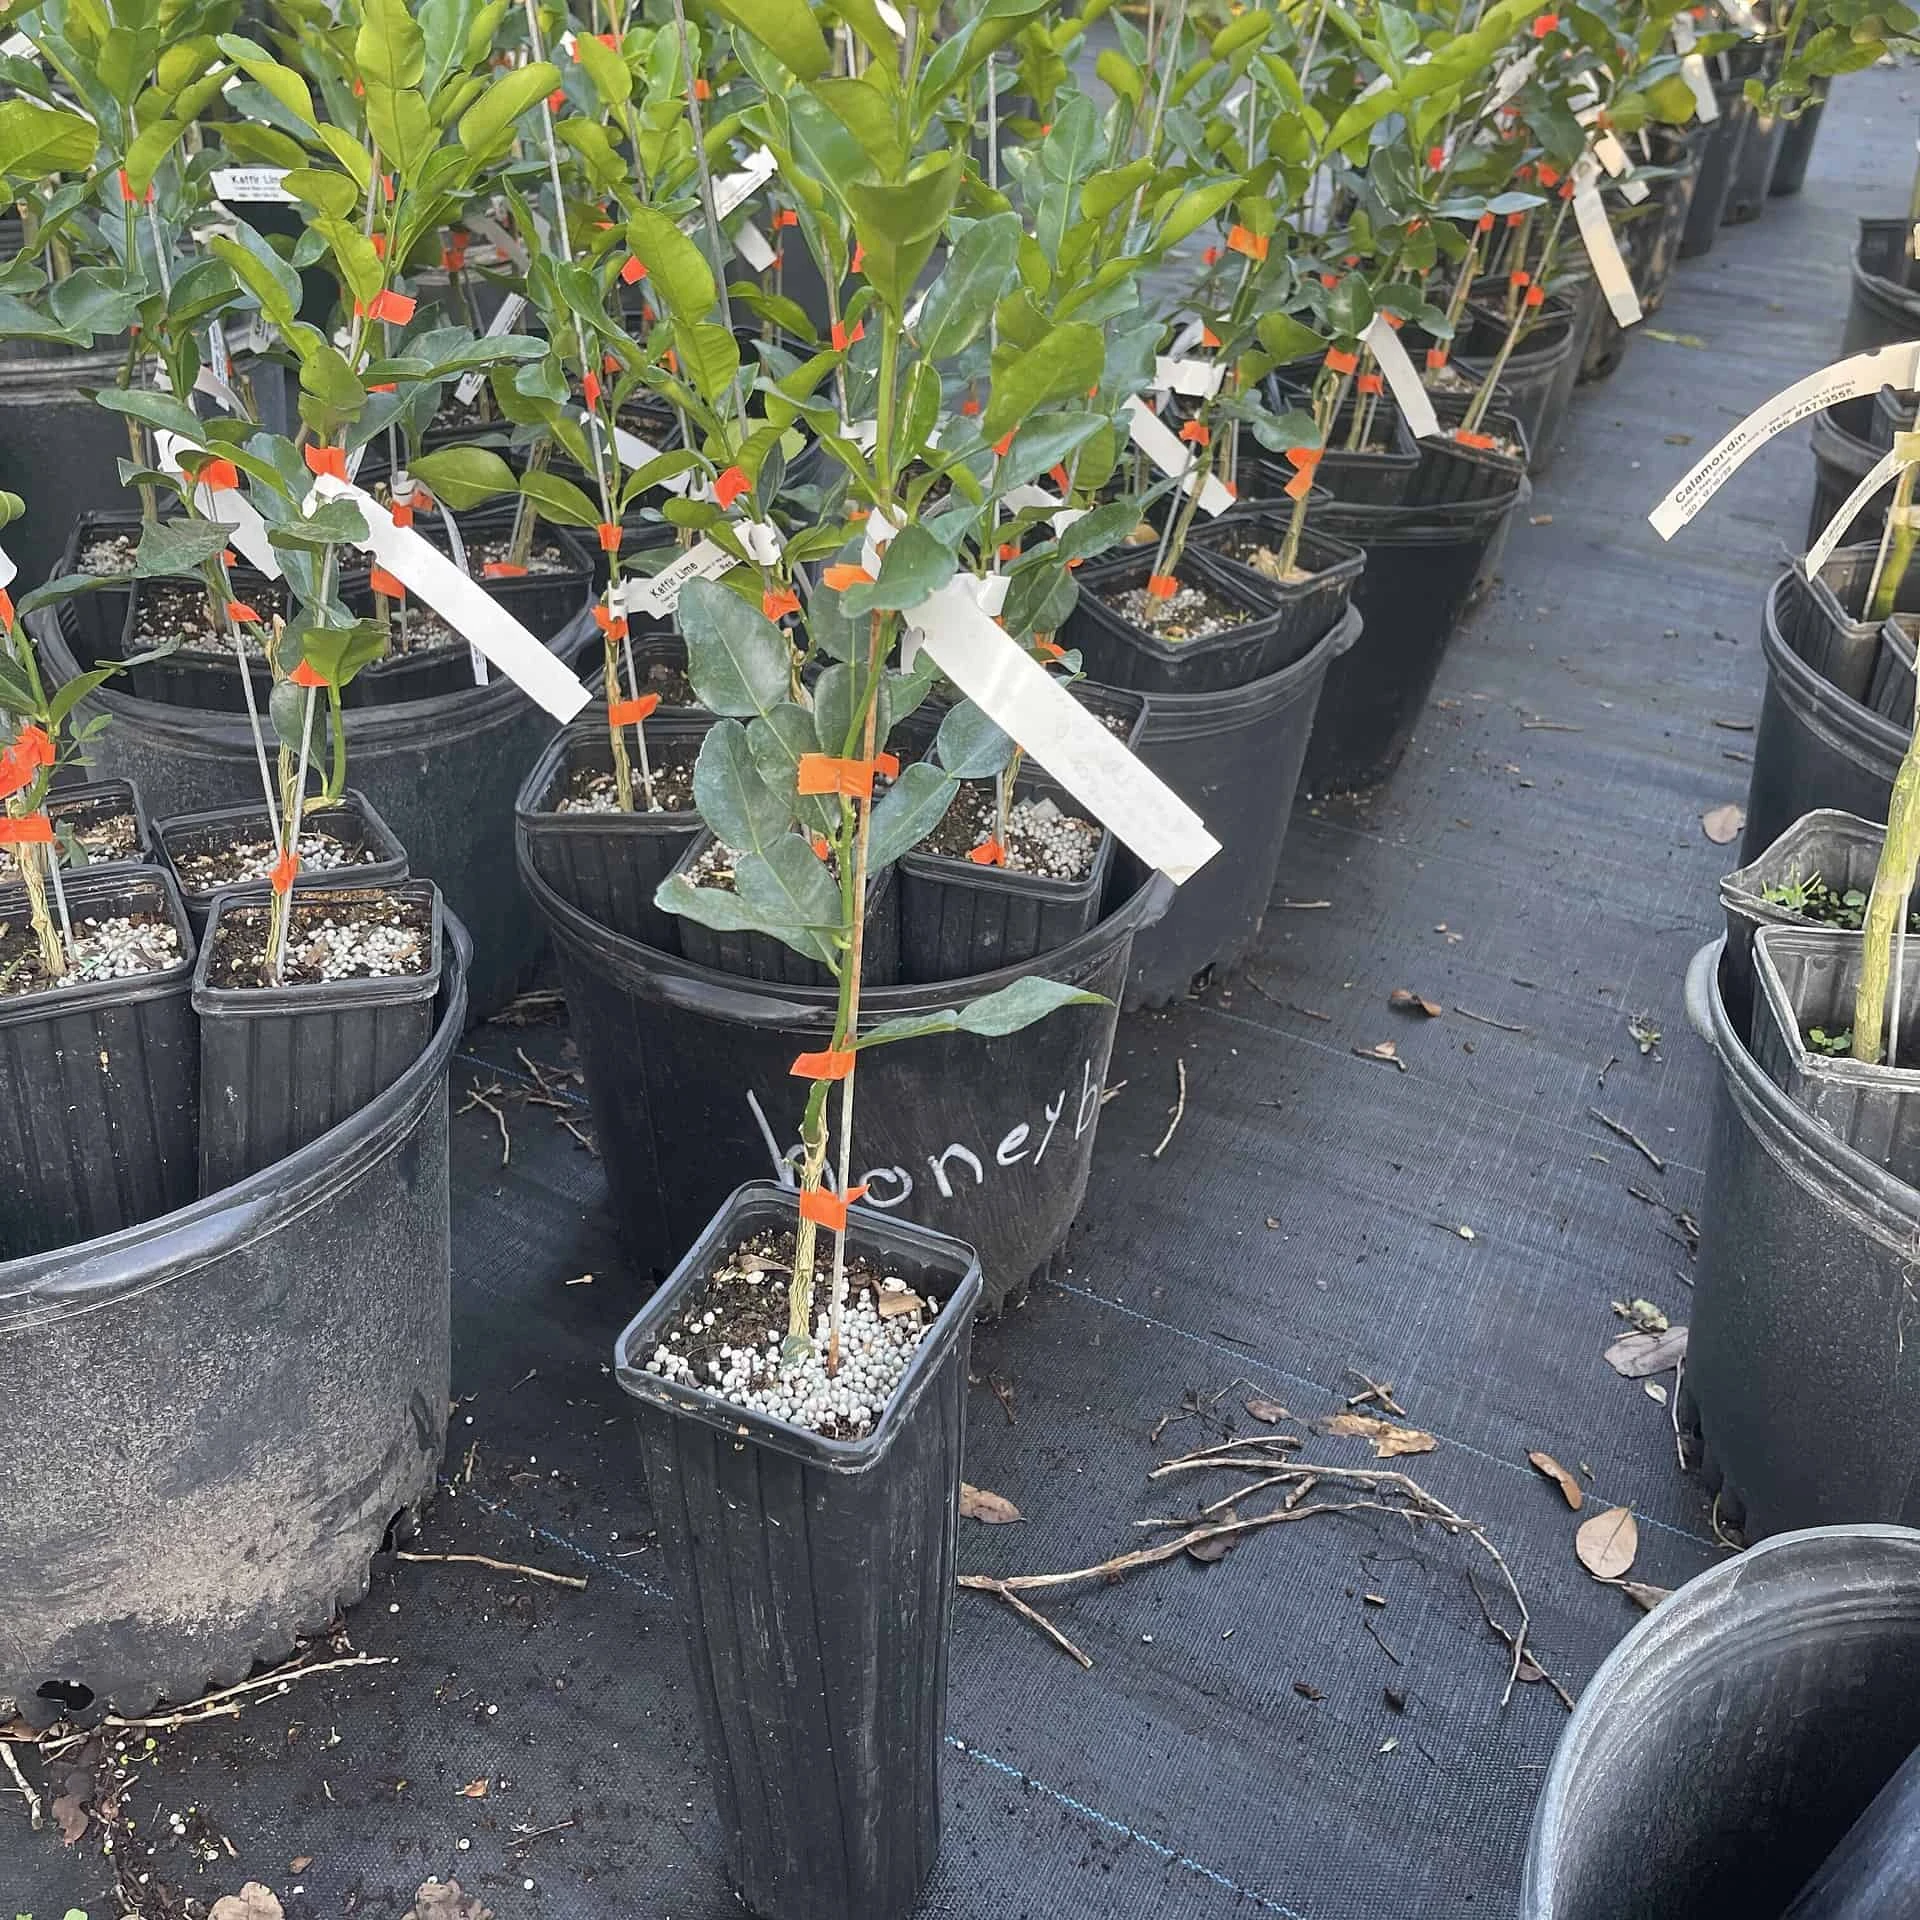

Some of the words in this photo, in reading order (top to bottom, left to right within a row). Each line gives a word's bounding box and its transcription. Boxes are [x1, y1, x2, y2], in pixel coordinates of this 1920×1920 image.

[1675, 432, 1746, 503] Calamondin
[650, 574, 677, 599] Kaffir
[678, 562, 698, 580] Lime
